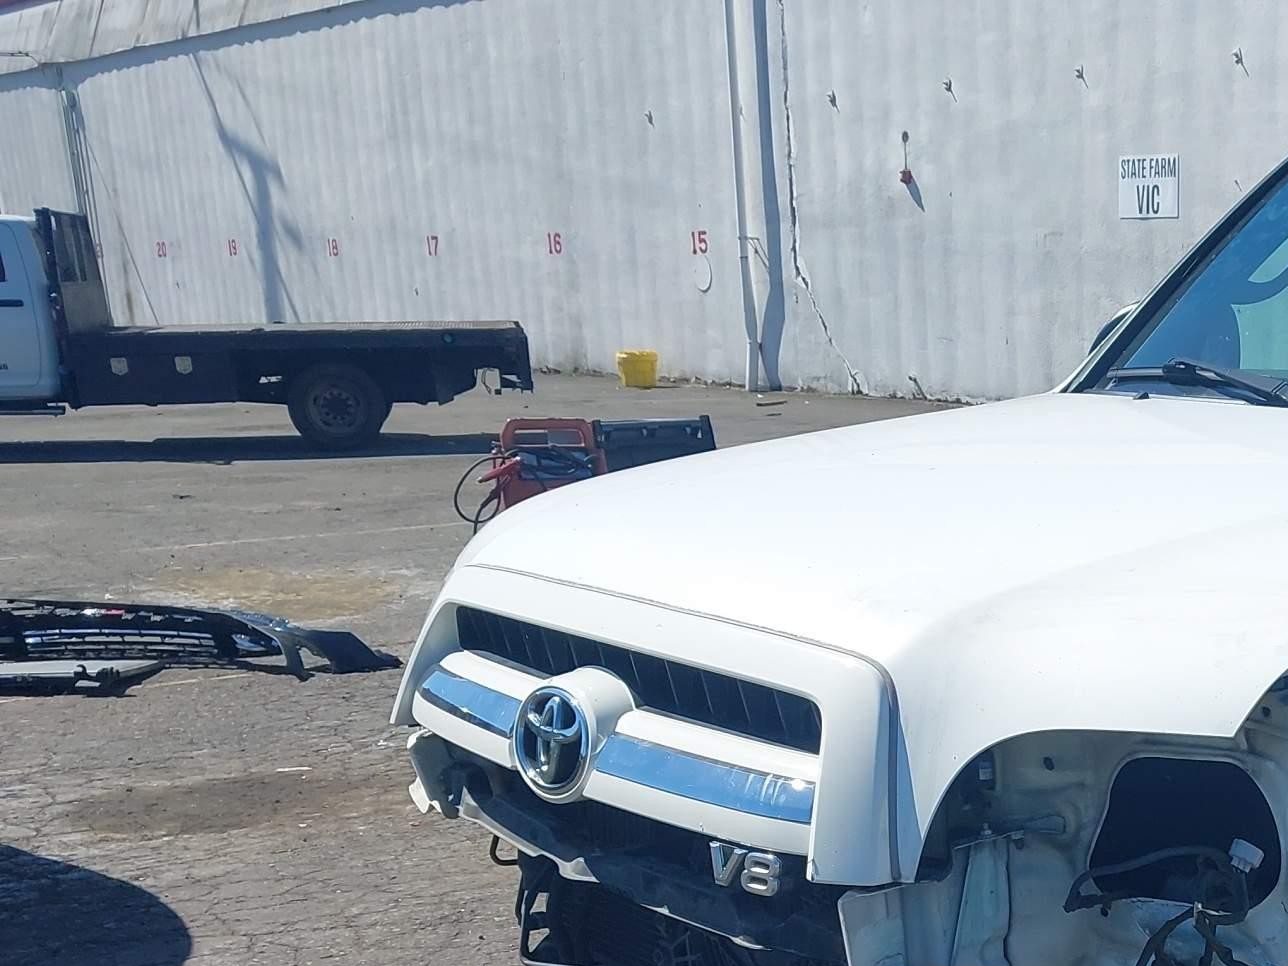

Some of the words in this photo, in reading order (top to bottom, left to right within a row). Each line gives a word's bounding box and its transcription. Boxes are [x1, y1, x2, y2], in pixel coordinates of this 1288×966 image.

[1120, 158, 1147, 179] STATE
[1150, 157, 1177, 178] FARM
[1136, 184, 1160, 215] VIC
[156, 241, 167, 258] 20
[227, 239, 238, 256] 19
[327, 239, 339, 257] 18
[426, 235, 439, 256] 17
[547, 232, 562, 254] 16
[691, 230, 708, 255] 15
[709, 841, 781, 896] V8
